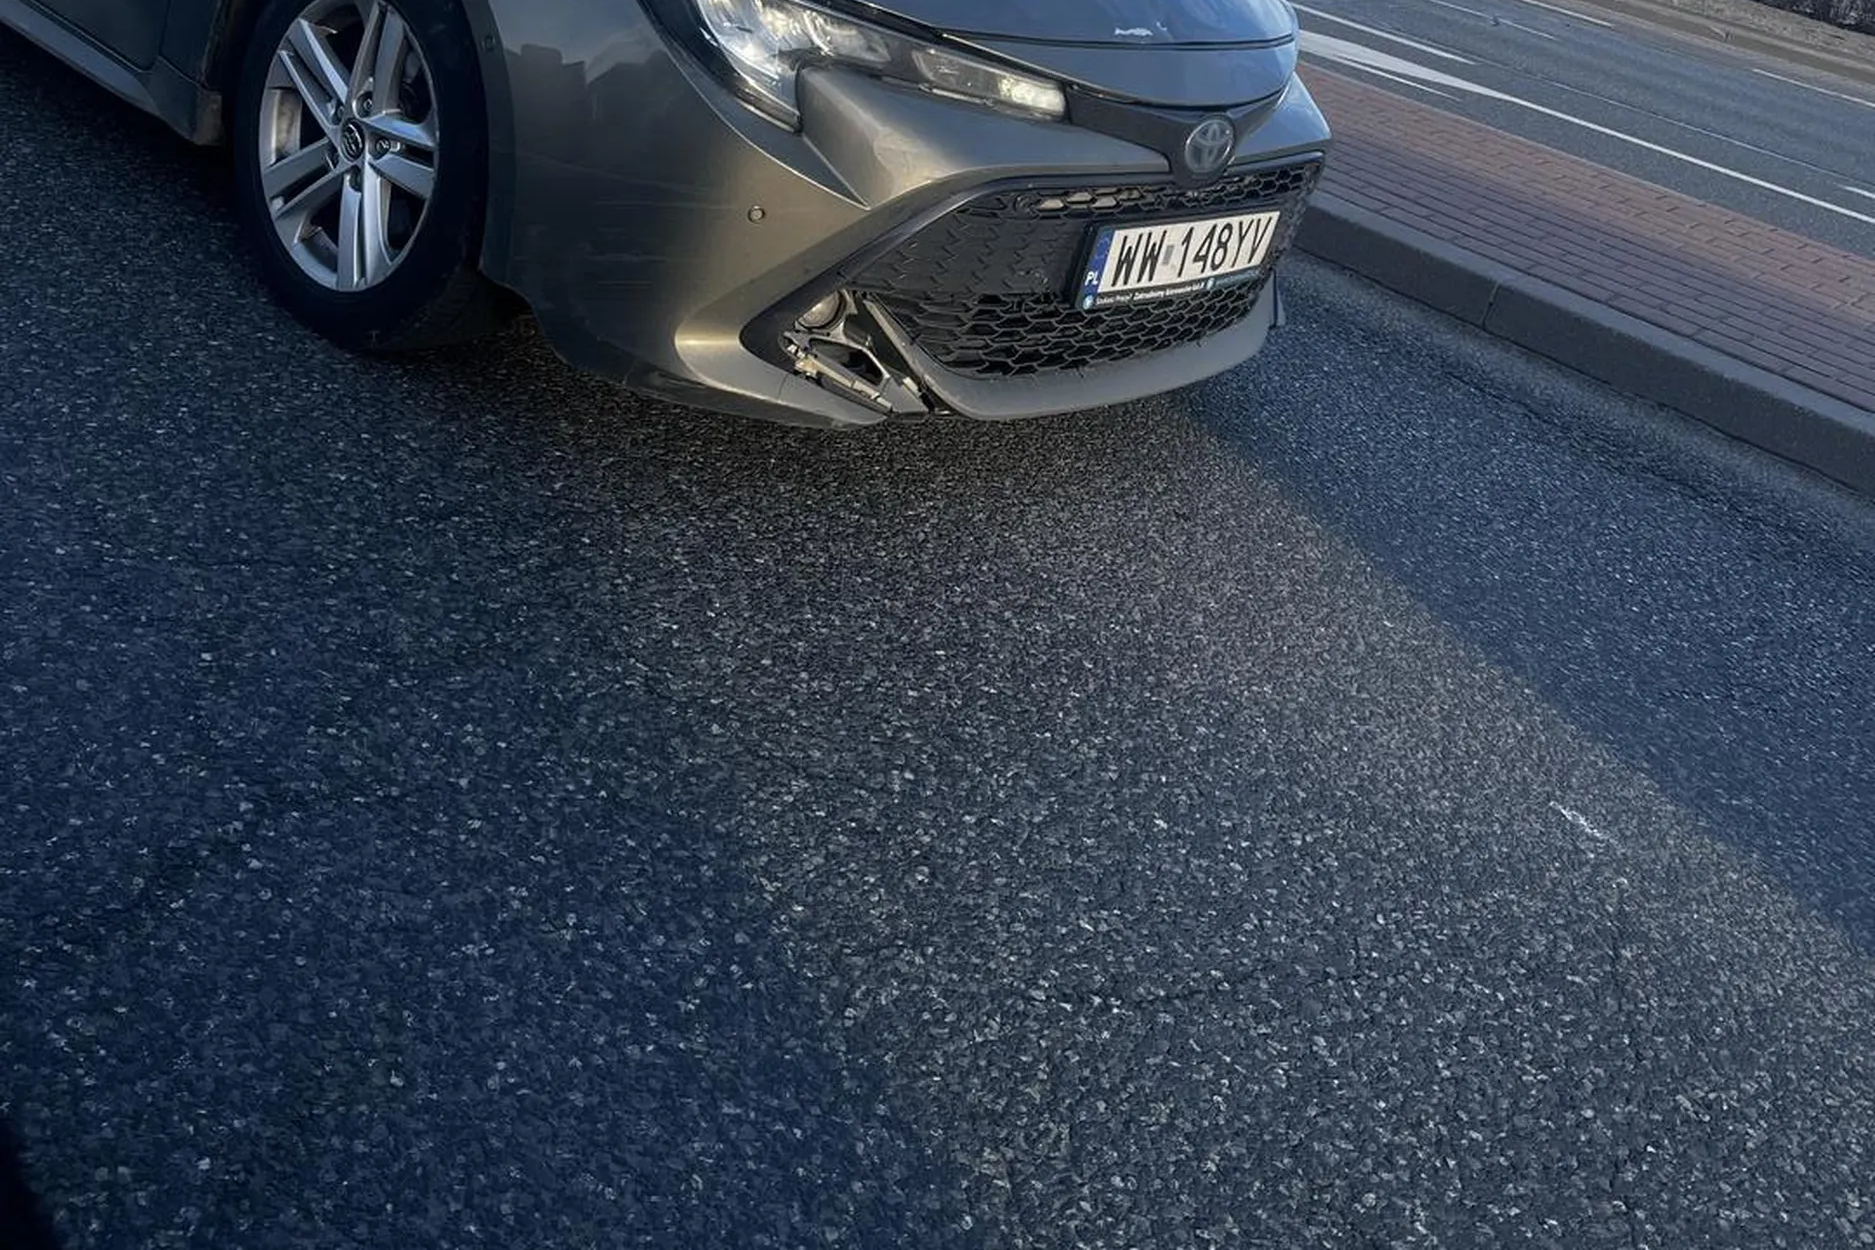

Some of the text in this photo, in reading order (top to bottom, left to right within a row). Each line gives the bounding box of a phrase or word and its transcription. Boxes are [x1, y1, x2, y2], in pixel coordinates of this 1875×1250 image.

[1111, 216, 1273, 287] WW 148YV
[1084, 271, 1098, 286] PL
